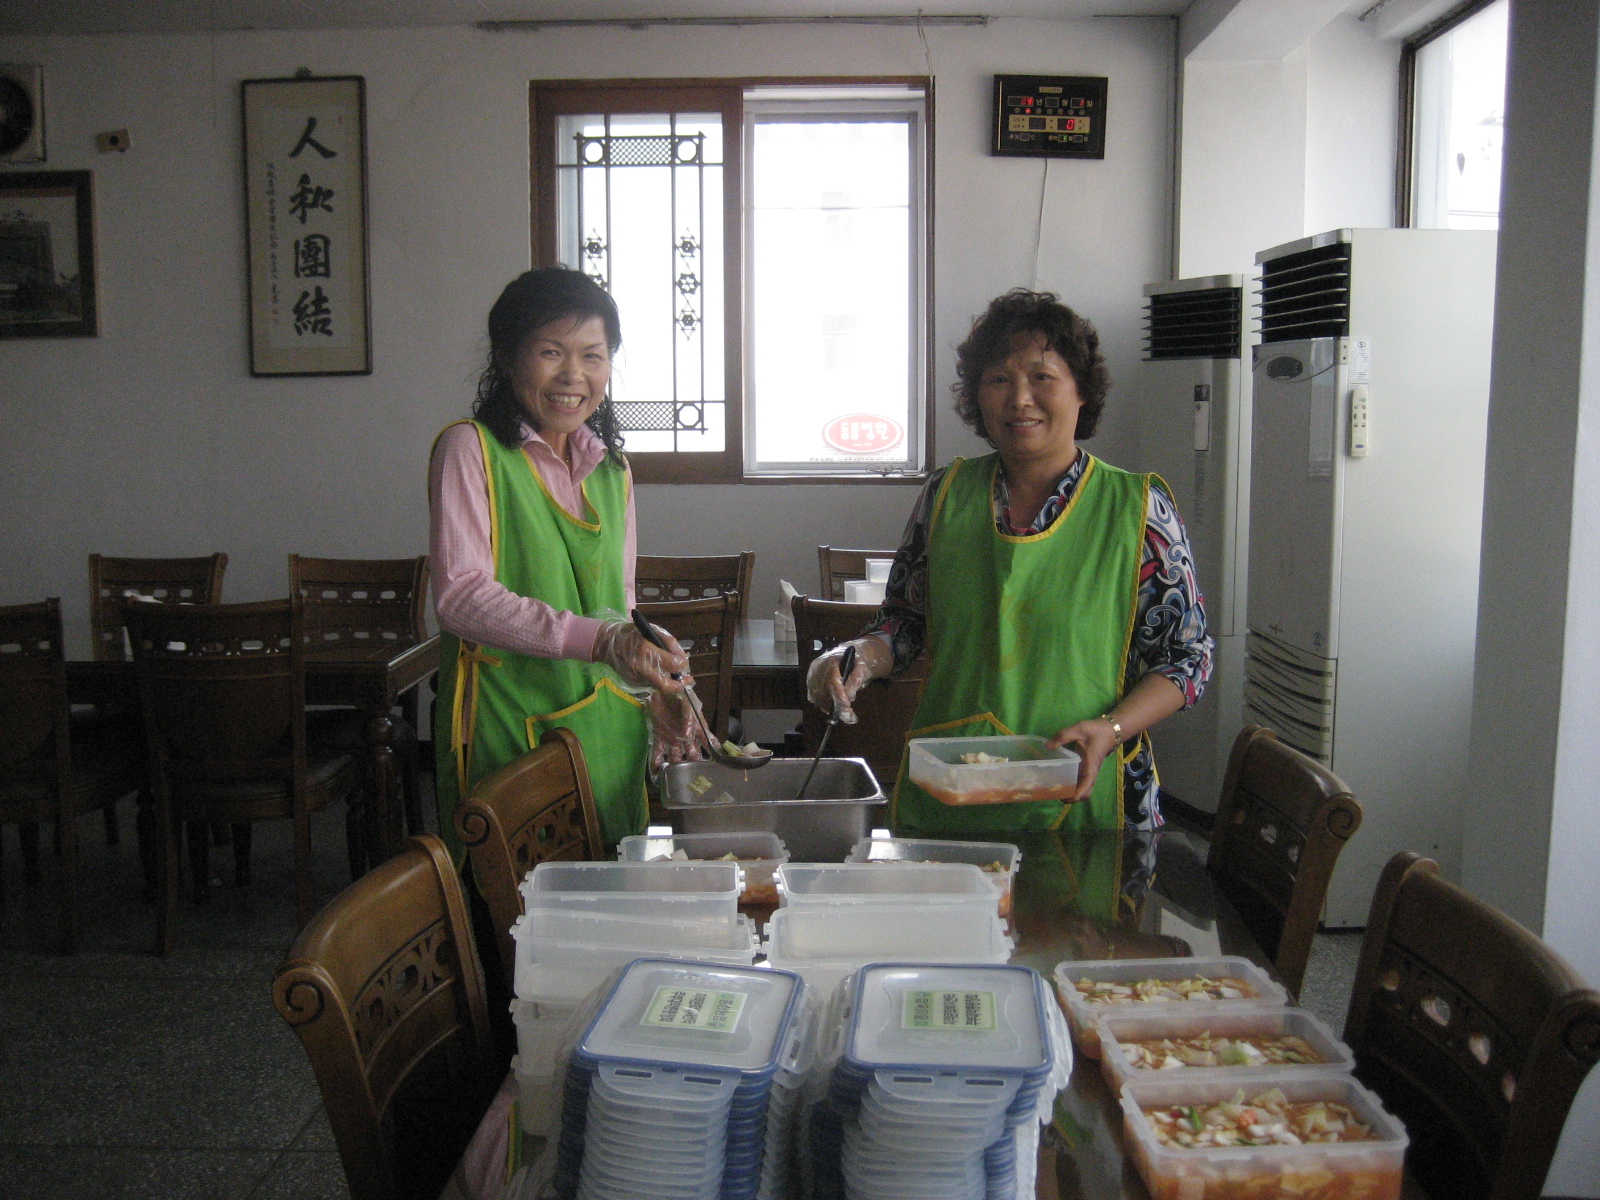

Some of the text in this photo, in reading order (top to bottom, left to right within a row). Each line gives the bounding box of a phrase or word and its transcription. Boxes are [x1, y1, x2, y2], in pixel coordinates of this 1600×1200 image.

[289, 116, 338, 337] 人和團結
[841, 422, 889, 440] 동물병원
